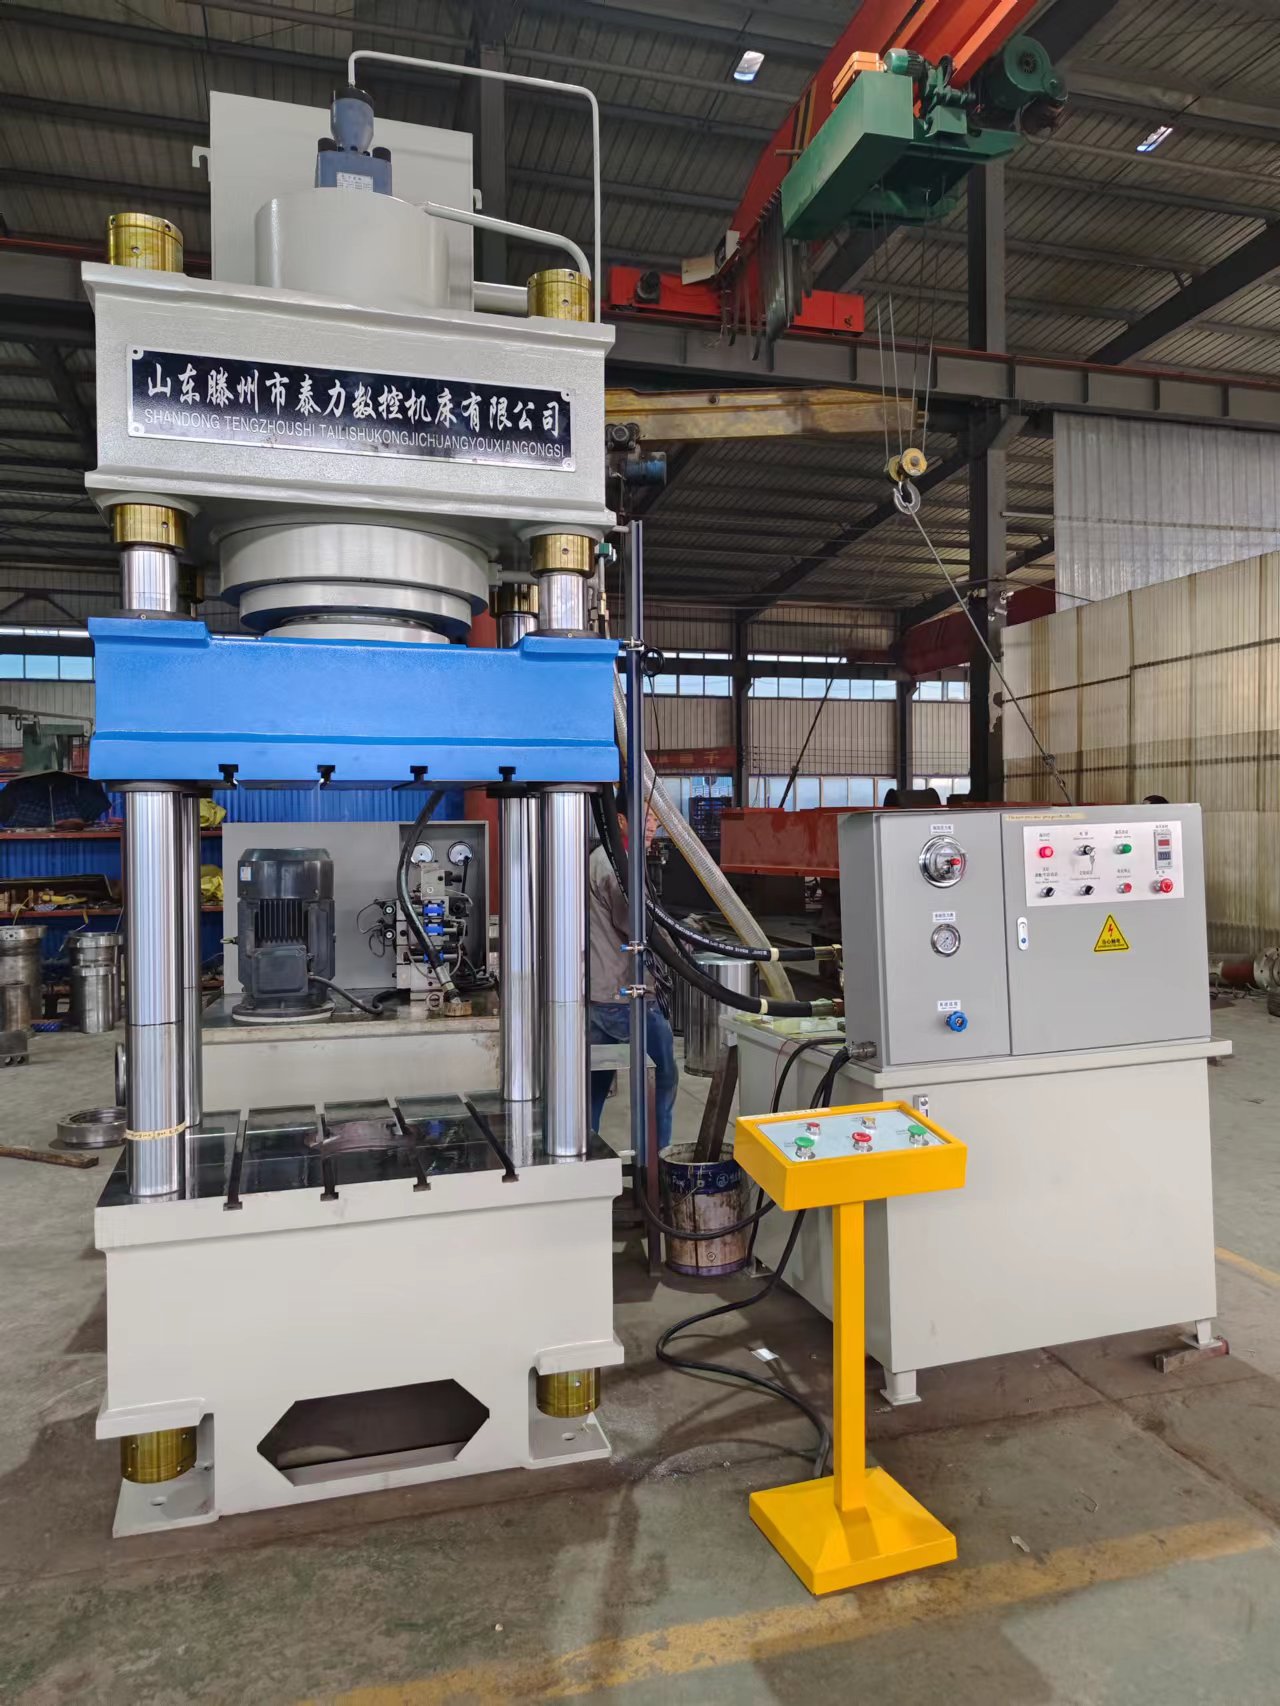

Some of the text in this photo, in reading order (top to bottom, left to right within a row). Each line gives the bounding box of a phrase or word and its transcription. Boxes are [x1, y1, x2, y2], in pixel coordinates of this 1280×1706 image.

[147, 362, 560, 438] 山东滕州市泰力数控机床有限公司
[144, 408, 566, 458] SHANDONG TENGZHOUSHI TAILISHUKONGJICHUANGYOUXIANGONGSI
